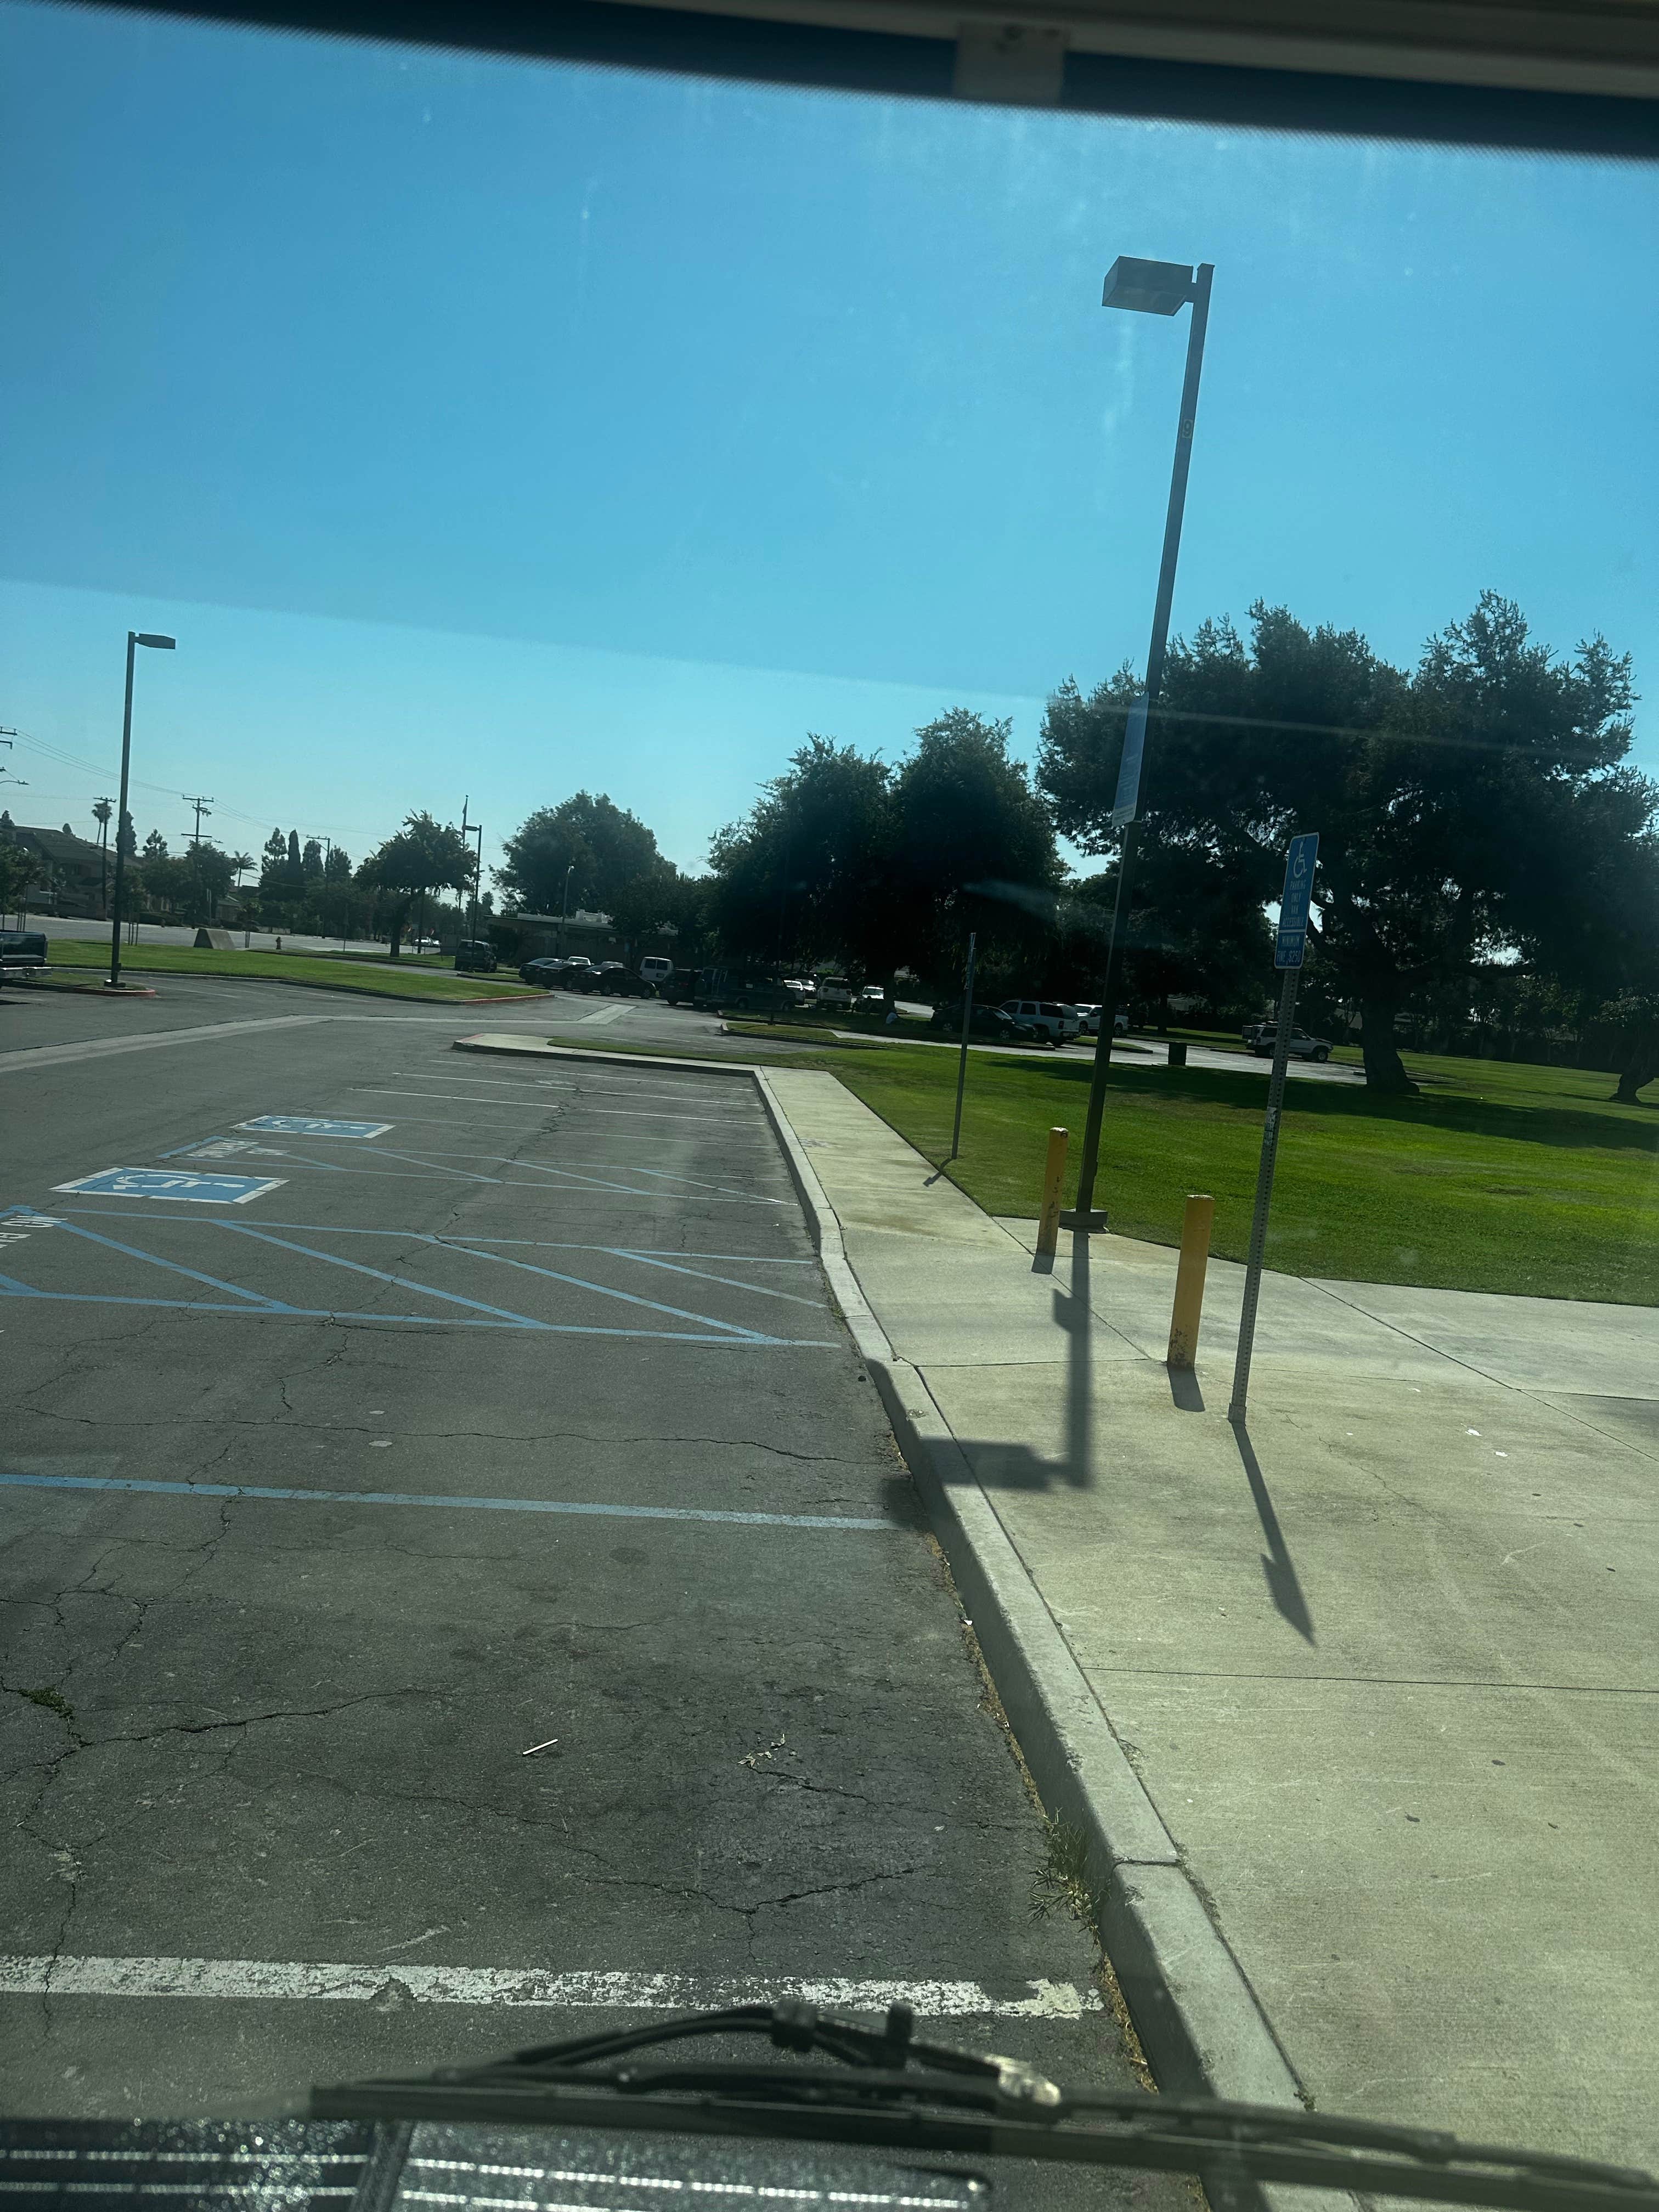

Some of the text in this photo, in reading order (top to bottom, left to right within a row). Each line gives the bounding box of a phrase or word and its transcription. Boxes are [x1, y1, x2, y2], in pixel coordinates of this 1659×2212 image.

[1290, 879, 1306, 889] PARKING
[1291, 893, 1301, 902] ONLY
[1283, 917, 1304, 927] ACCESSIBLE
[1281, 934, 1300, 947] MINIMUM
[1277, 950, 1301, 963] FINE $250
[1, 1215, 68, 1228] NO
